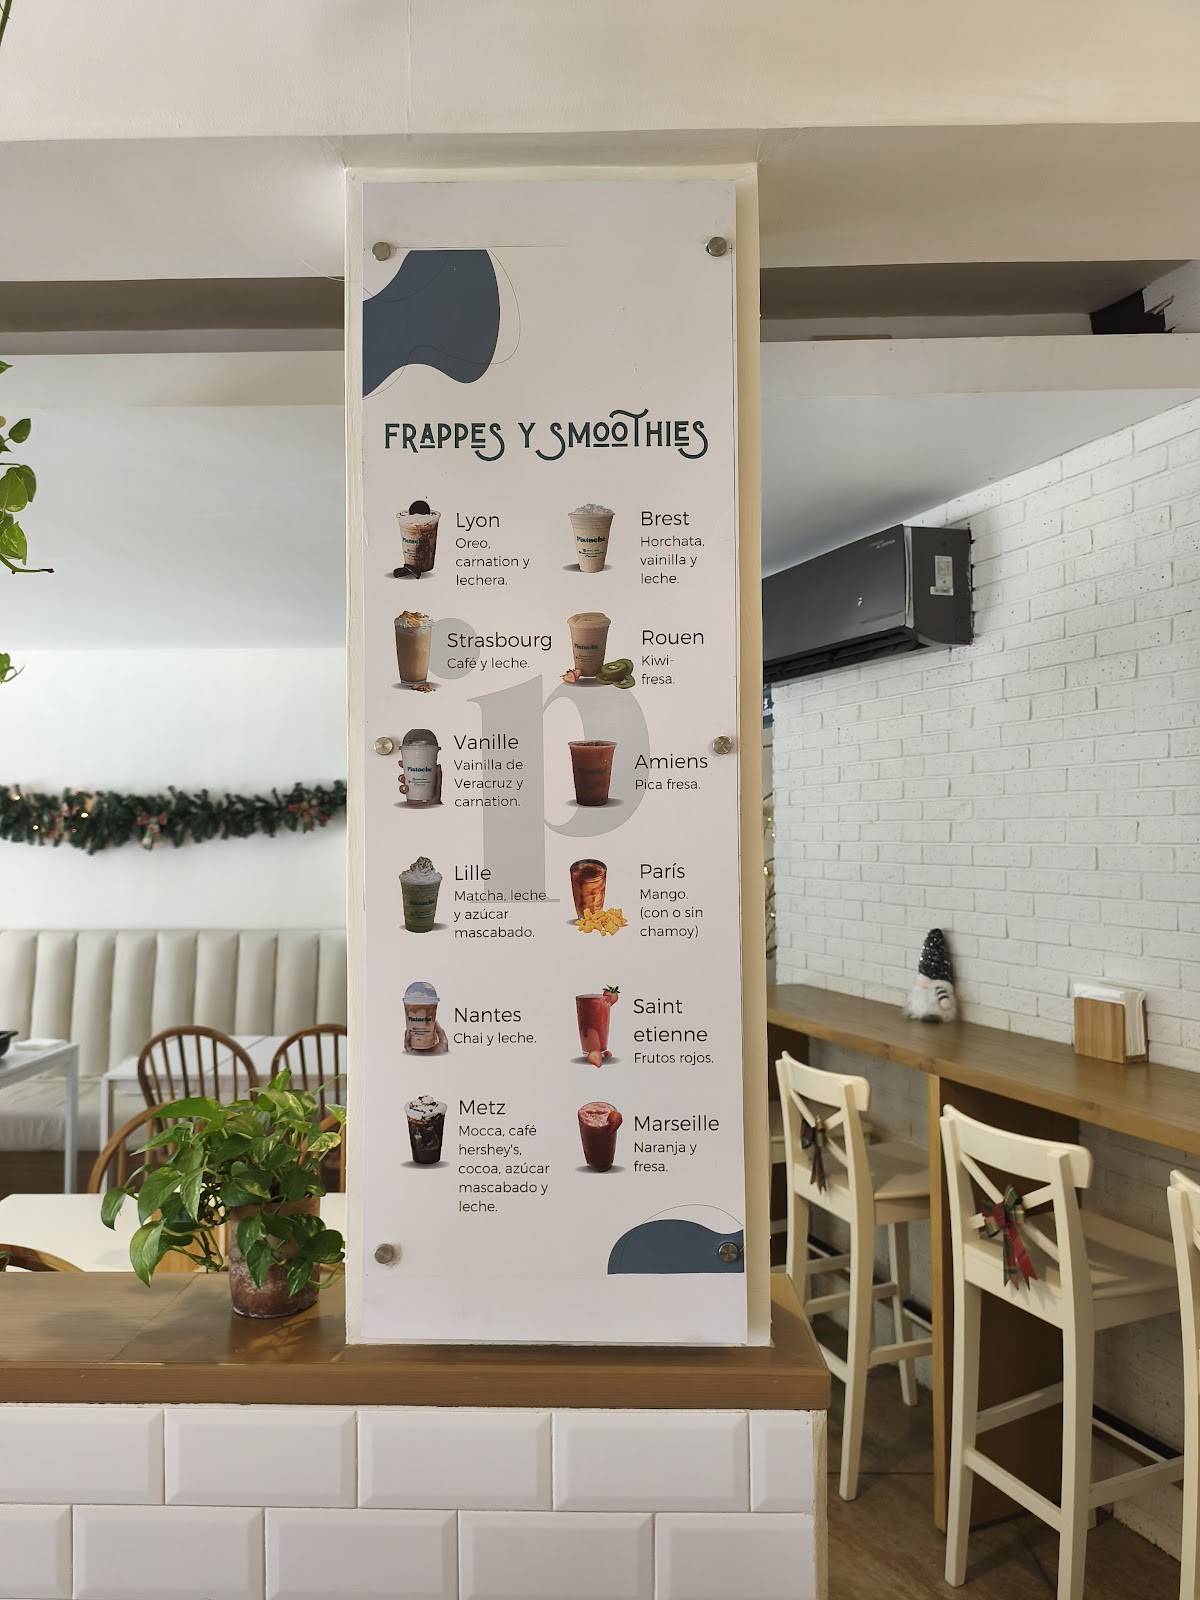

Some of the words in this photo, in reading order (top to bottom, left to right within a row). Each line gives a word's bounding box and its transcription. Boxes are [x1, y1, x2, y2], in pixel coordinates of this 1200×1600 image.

[385, 423, 505, 461] FRAPPES
[518, 423, 535, 448] Y
[536, 408, 708, 461] SMOOTHIES
[456, 512, 500, 532] Lyon
[641, 510, 691, 527] Brest
[455, 555, 519, 568] carnation
[522, 557, 530, 570] y
[639, 553, 687, 566] vainilla
[689, 556, 698, 568] y
[456, 573, 508, 586] lechera.
[640, 572, 680, 585] leche.
[447, 631, 552, 652] Strasbourg
[642, 629, 704, 646] Rouen
[447, 657, 477, 671] Café
[480, 659, 488, 672] y
[491, 656, 530, 669] leche.
[641, 672, 676, 686] fresa.
[453, 733, 519, 750] Vanille
[453, 758, 502, 771] Vainilla
[506, 758, 524, 771] de
[634, 753, 709, 770] Amiens
[453, 777, 513, 789] Veracruz
[515, 779, 524, 791] y
[635, 777, 663, 791] Pica
[666, 778, 701, 790] fresa.
[454, 795, 521, 808] carnation.
[455, 864, 492, 881] Lille
[640, 862, 686, 879] París
[453, 911, 462, 923] y
[464, 908, 509, 920] azúcar
[640, 906, 669, 920] (con
[671, 908, 682, 919] o
[684, 906, 703, 918] sin
[454, 925, 535, 939] mascabado.
[639, 924, 699, 940] chamoy)
[632, 997, 683, 1015] Saint
[454, 1007, 522, 1023] Nantes
[453, 1032, 483, 1044] Chai
[486, 1034, 494, 1047] y
[498, 1031, 537, 1044] leche.
[633, 1026, 708, 1043] etienne
[634, 1052, 676, 1064] Frutos
[679, 1051, 714, 1066] rojos.
[459, 1099, 507, 1116] Metz
[458, 1125, 506, 1137] Mocca,
[508, 1124, 537, 1137] café
[634, 1114, 720, 1132] Marseille
[458, 1143, 522, 1158] hershey's,
[634, 1140, 686, 1156] Naranja
[689, 1143, 697, 1156] y
[458, 1165, 502, 1176] cocoa,
[504, 1161, 551, 1175] azúcar
[633, 1159, 668, 1173] fresa.
[458, 1180, 538, 1193] mascabado
[540, 1183, 549, 1196] y
[458, 1200, 499, 1213] leche.
